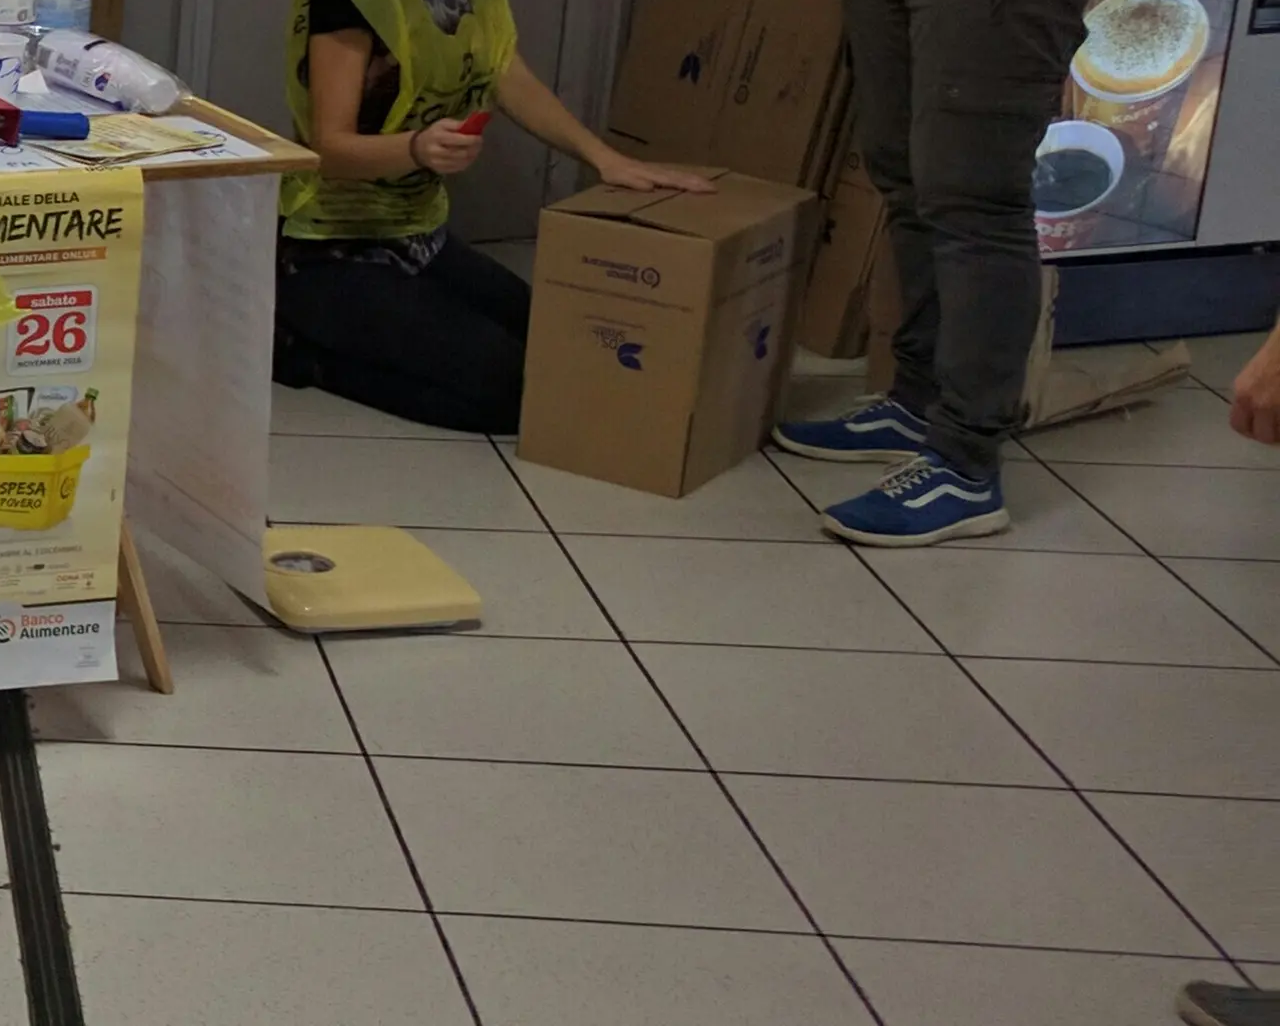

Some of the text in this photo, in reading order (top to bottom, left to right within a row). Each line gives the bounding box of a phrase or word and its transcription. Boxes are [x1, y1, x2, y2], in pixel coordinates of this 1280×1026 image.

[34, 191, 80, 206] DELLA
[61, 248, 98, 261] ONLUS
[30, 294, 78, 309] sabato
[15, 310, 88, 357] 26
[16, 357, 62, 369] NOVEMBRE
[0, 496, 43, 509] POVERO
[21, 613, 64, 626] Banco
[19, 622, 100, 639] Alimentare
